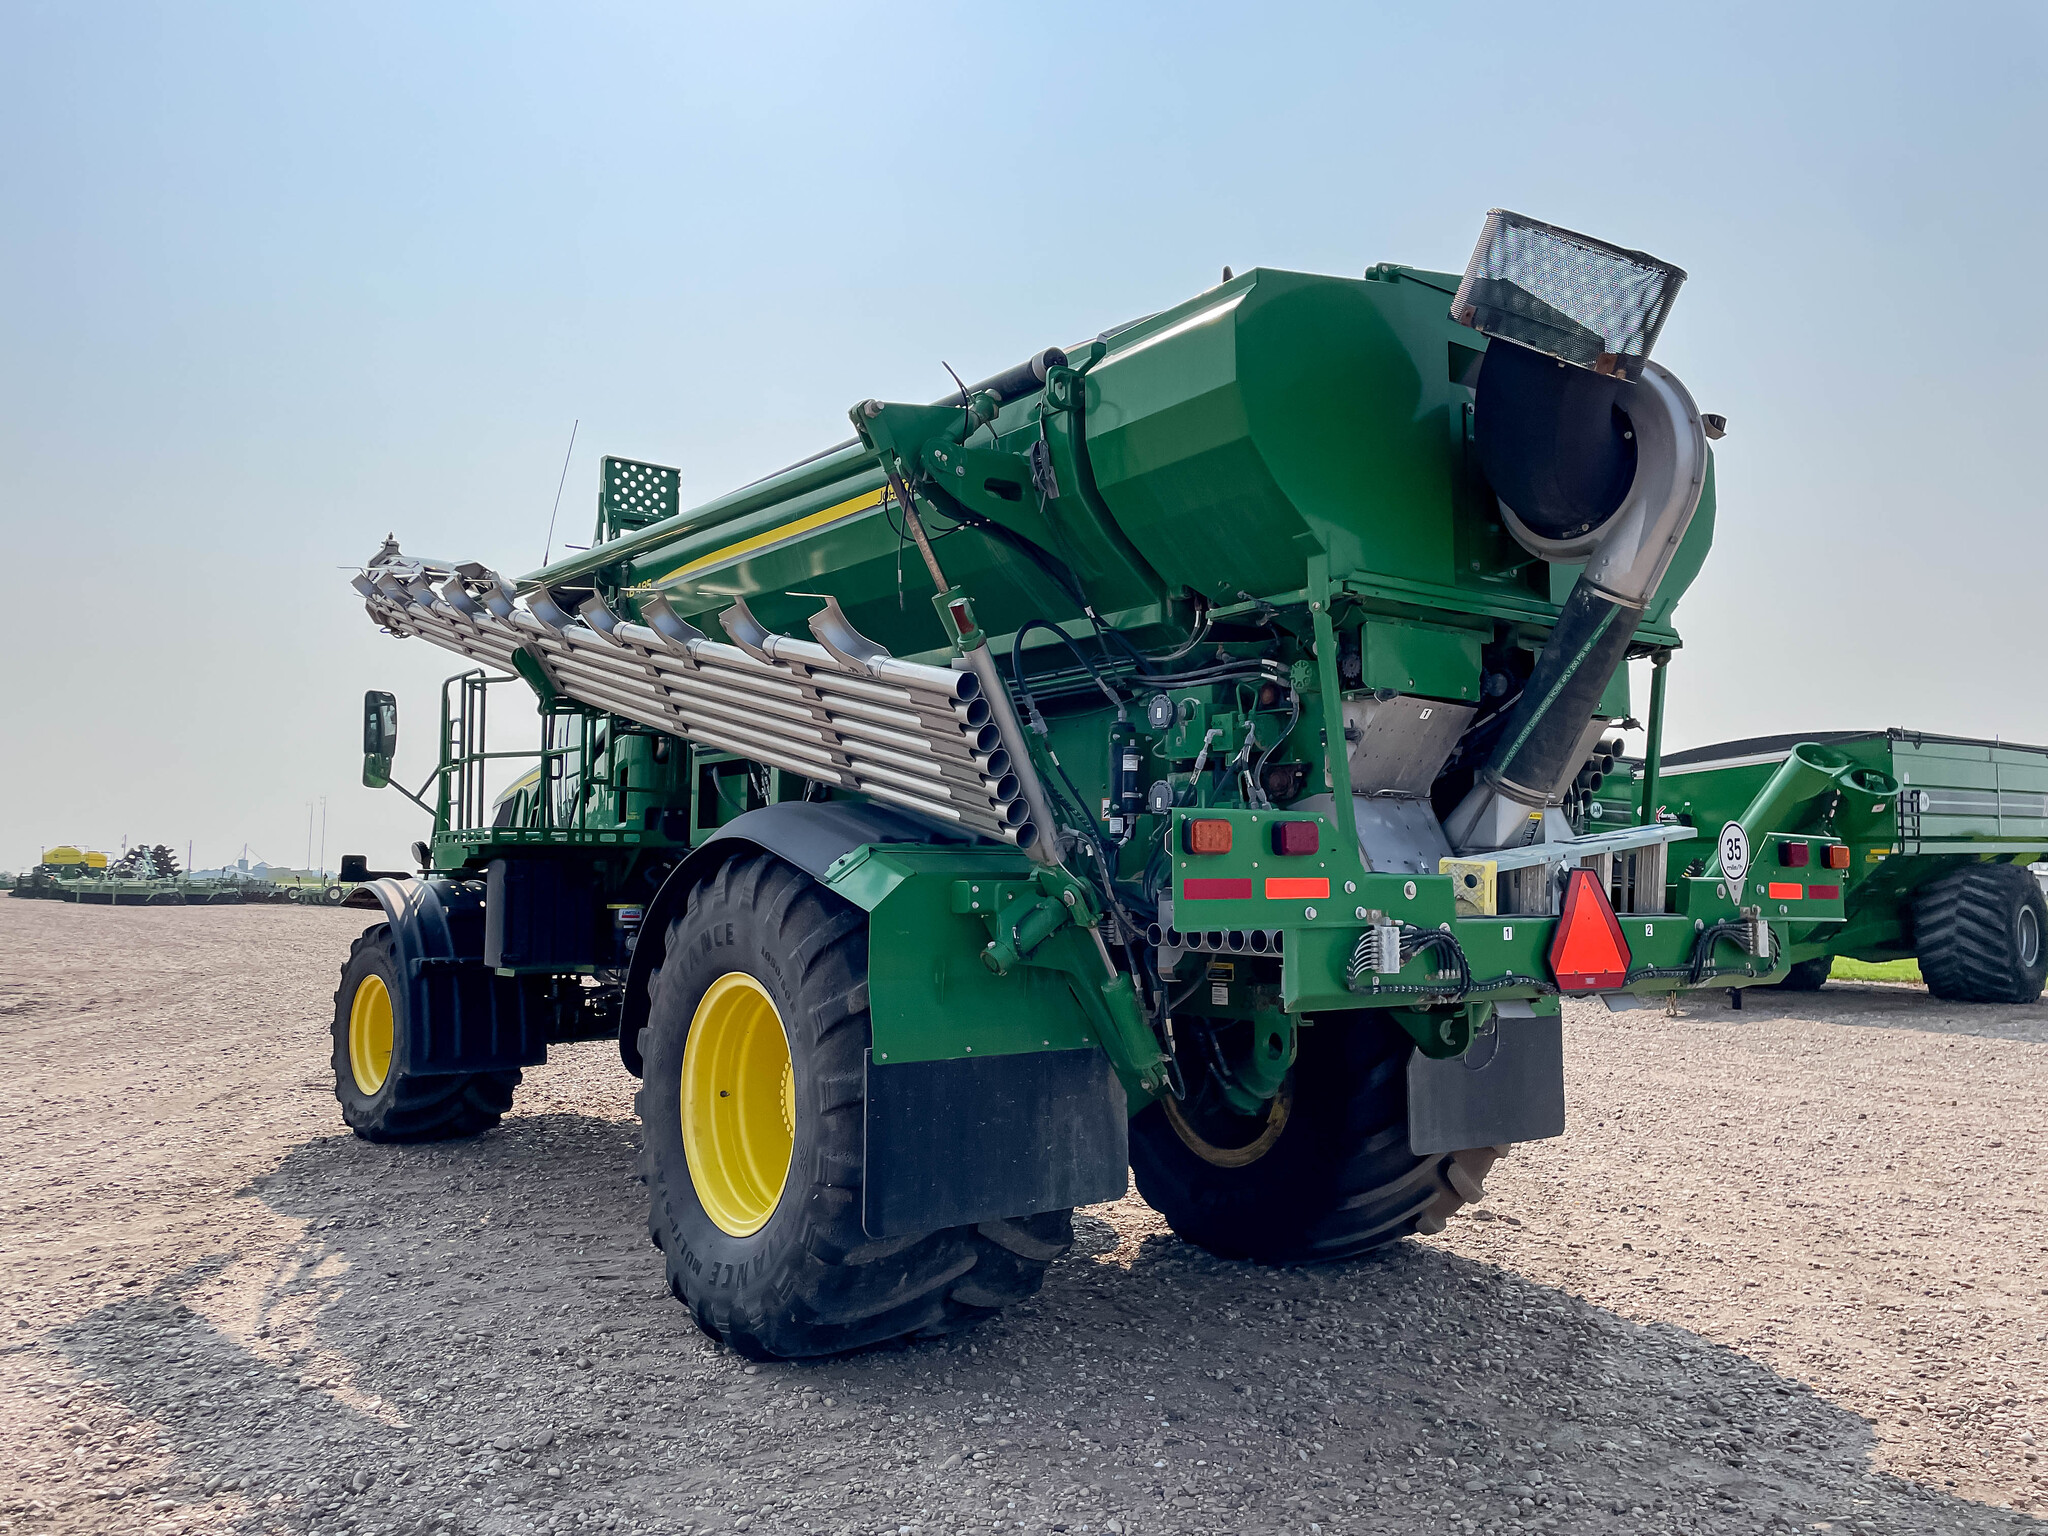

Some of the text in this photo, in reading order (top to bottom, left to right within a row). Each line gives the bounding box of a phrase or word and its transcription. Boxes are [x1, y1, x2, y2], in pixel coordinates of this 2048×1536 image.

[1518, 726, 1532, 744] WATER
[1529, 697, 1552, 727] DISCHARGE
[1550, 681, 1563, 698] HOSE
[1561, 668, 1572, 683] 4PLY
[1569, 660, 1579, 671] 200
[1576, 650, 1587, 662] PSI
[1726, 838, 1741, 861] 35
